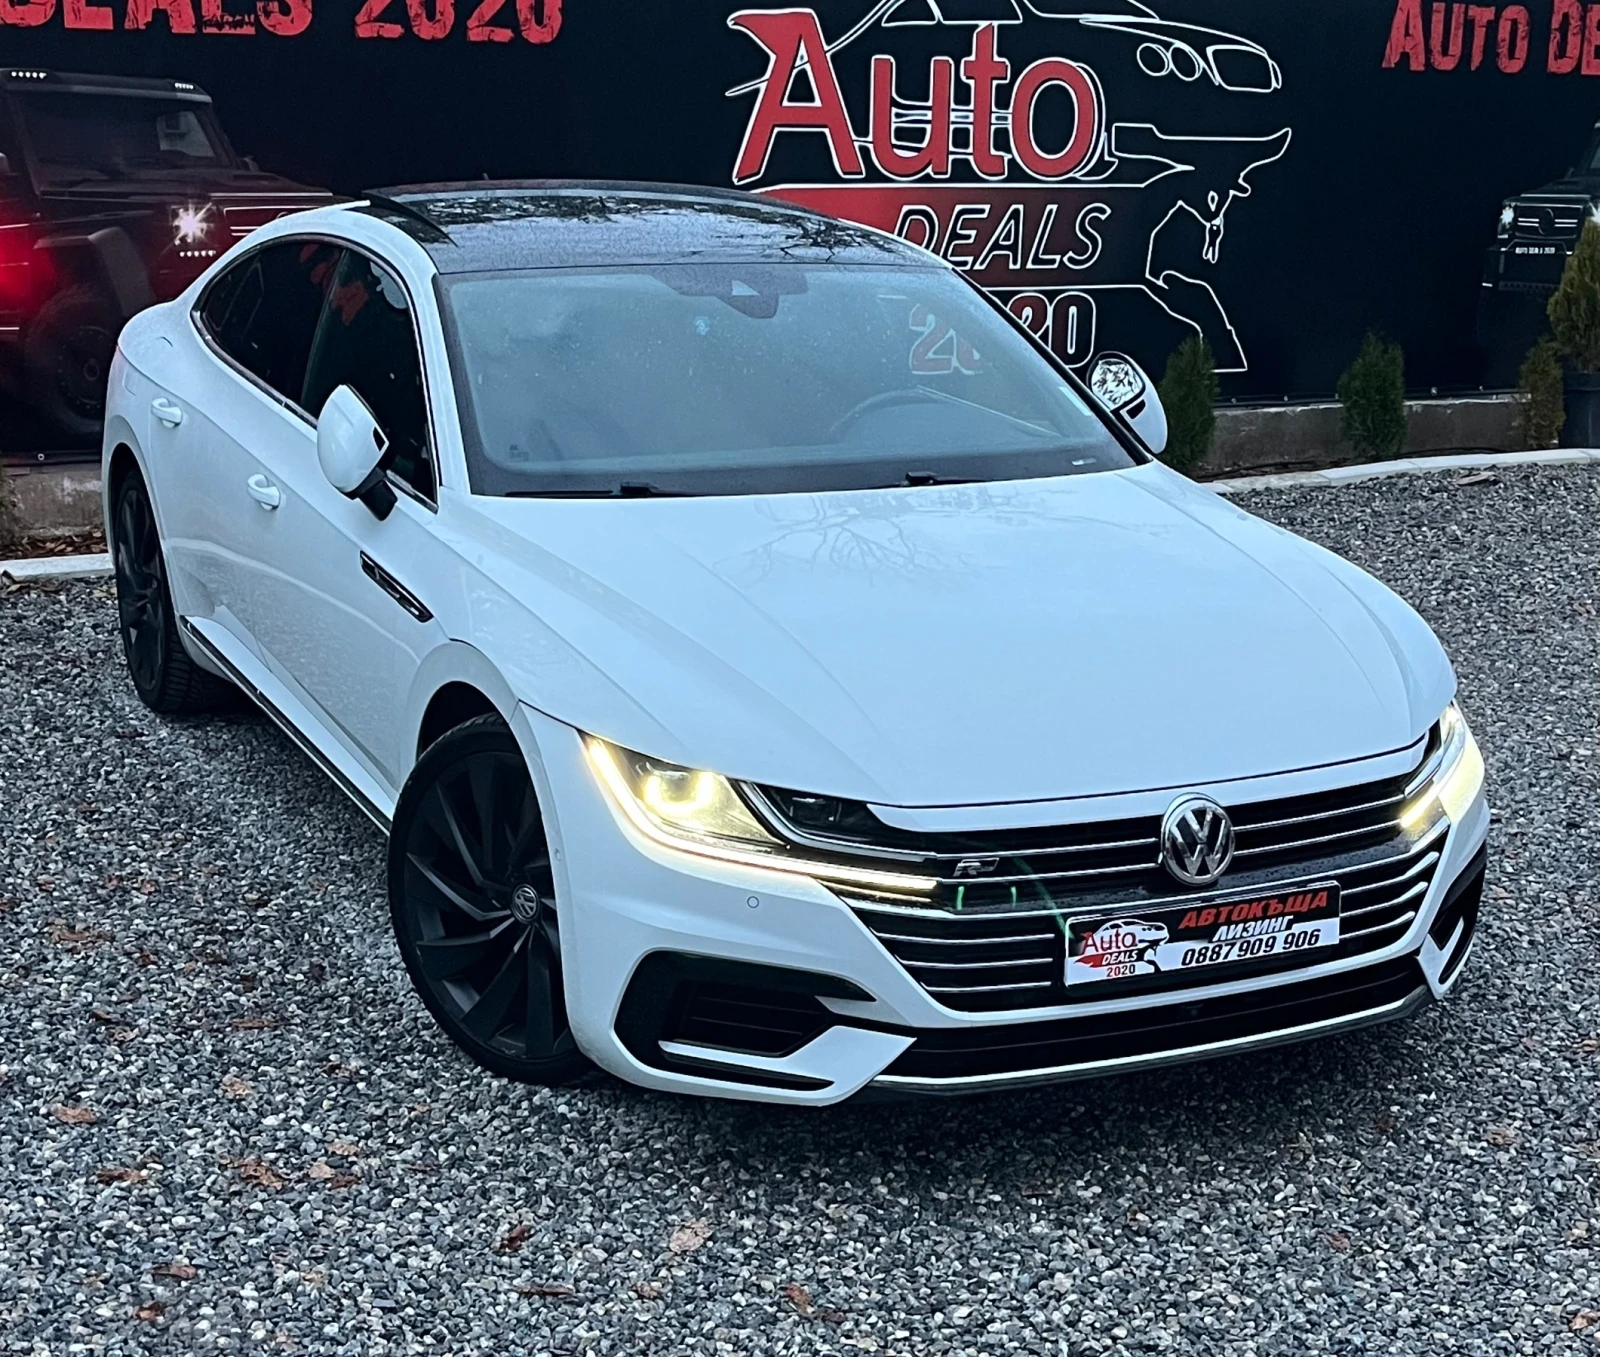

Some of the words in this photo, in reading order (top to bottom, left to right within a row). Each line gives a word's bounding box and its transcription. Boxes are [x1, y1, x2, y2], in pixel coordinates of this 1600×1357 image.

[1382, 0, 1530, 73] AUTO
[727, 9, 1098, 184] Auto
[893, 203, 1112, 270] DEALS
[1178, 891, 1329, 930] АВТОКЪЩА
[1080, 928, 1137, 955] Auto
[1212, 915, 1294, 943] ЛИЗИНГ
[1282, 928, 1322, 951] 906
[1101, 950, 1139, 966] DEALS
[1106, 963, 1137, 978] 2020
